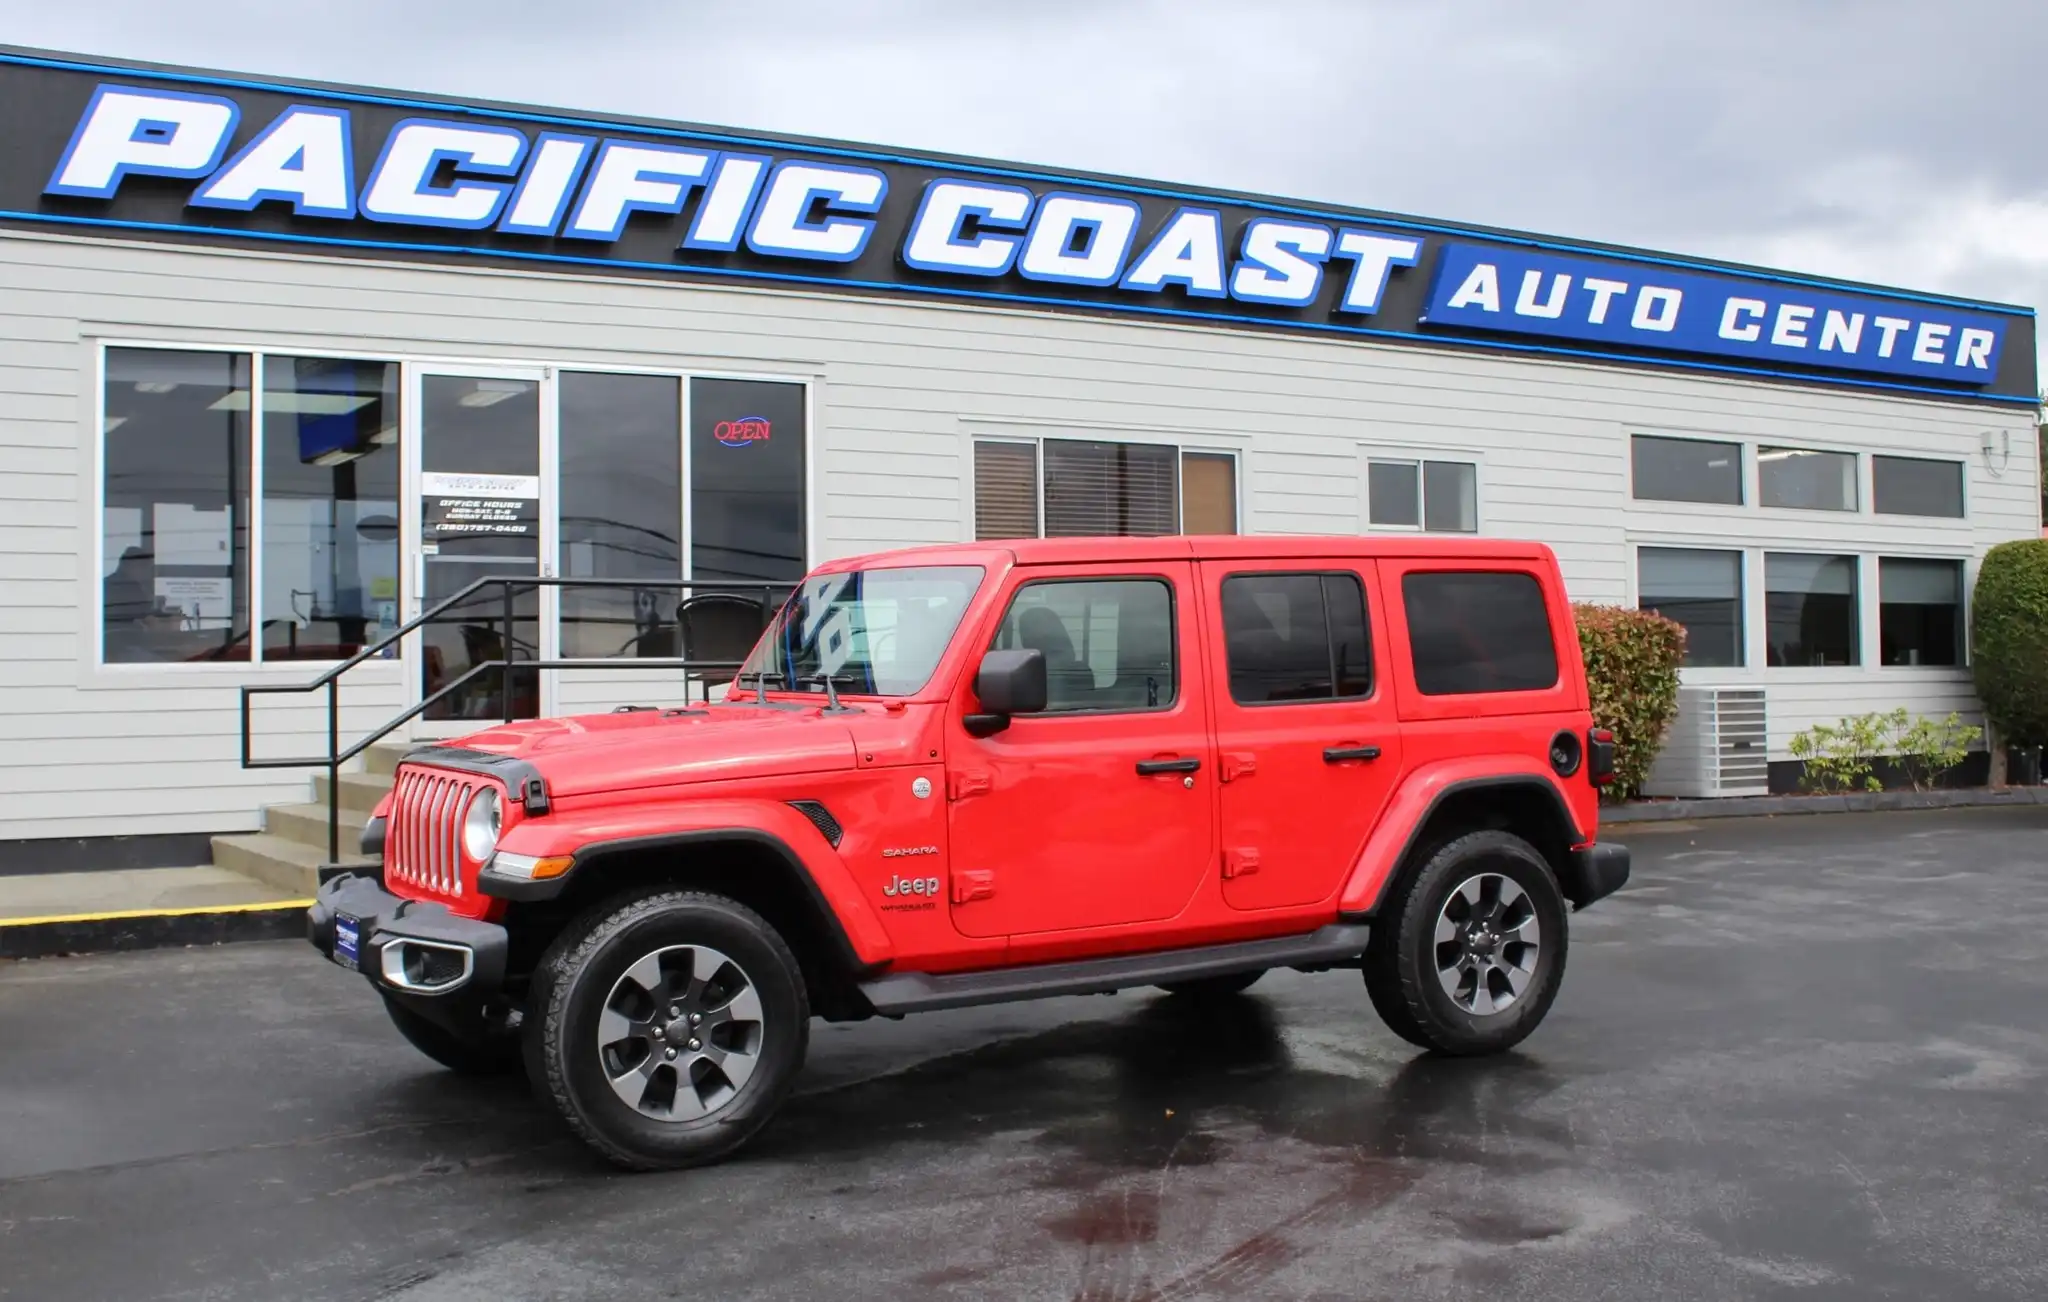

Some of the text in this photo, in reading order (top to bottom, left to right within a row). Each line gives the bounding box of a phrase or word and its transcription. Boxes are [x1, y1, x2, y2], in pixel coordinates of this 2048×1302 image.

[45, 83, 1424, 315] PACIFIC COAST
[1448, 263, 1996, 370] AUTO CENTER
[713, 420, 772, 441] OPEN
[439, 499, 523, 509] OFFICE HOURS
[883, 846, 939, 857] SAHARA
[883, 875, 940, 897] Jeep
